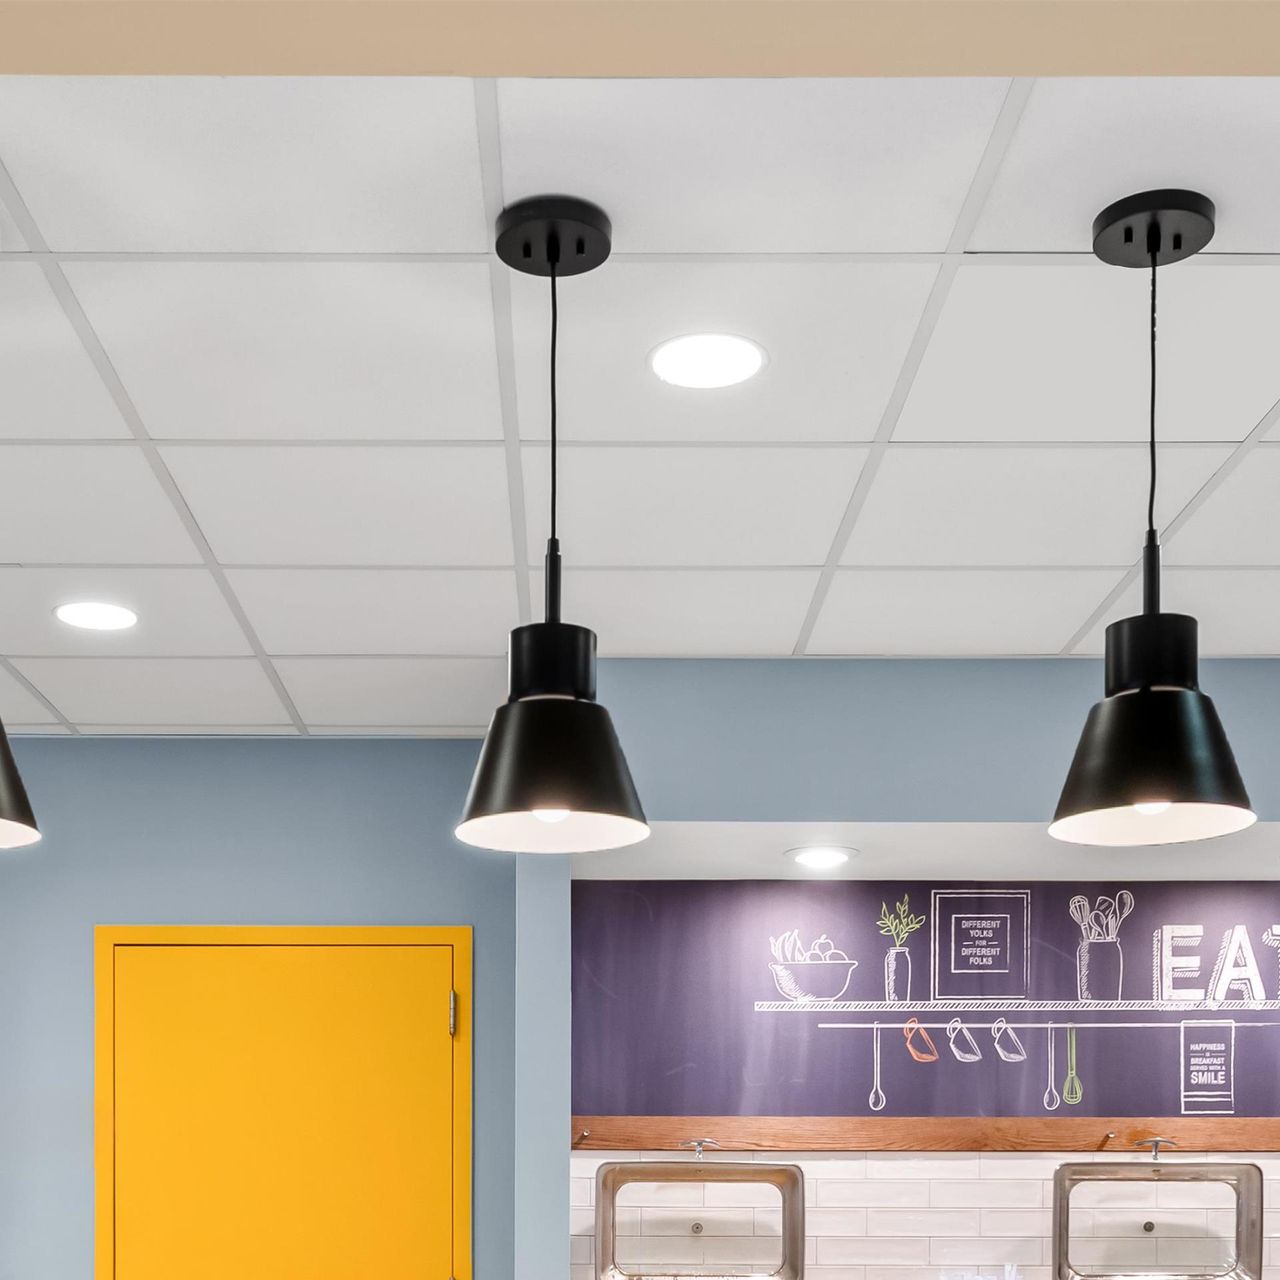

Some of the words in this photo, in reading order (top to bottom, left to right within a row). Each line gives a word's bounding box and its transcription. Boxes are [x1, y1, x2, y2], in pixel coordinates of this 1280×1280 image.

[961, 920, 1001, 928] DIFFERENT
[961, 948, 1001, 956] DIFFERENT
[969, 957, 993, 965] FOLKS
[1190, 1043, 1226, 1051] HAPPINESS
[1190, 1057, 1225, 1065] BREAKFAST
[1190, 1072, 1226, 1085] SMILE
